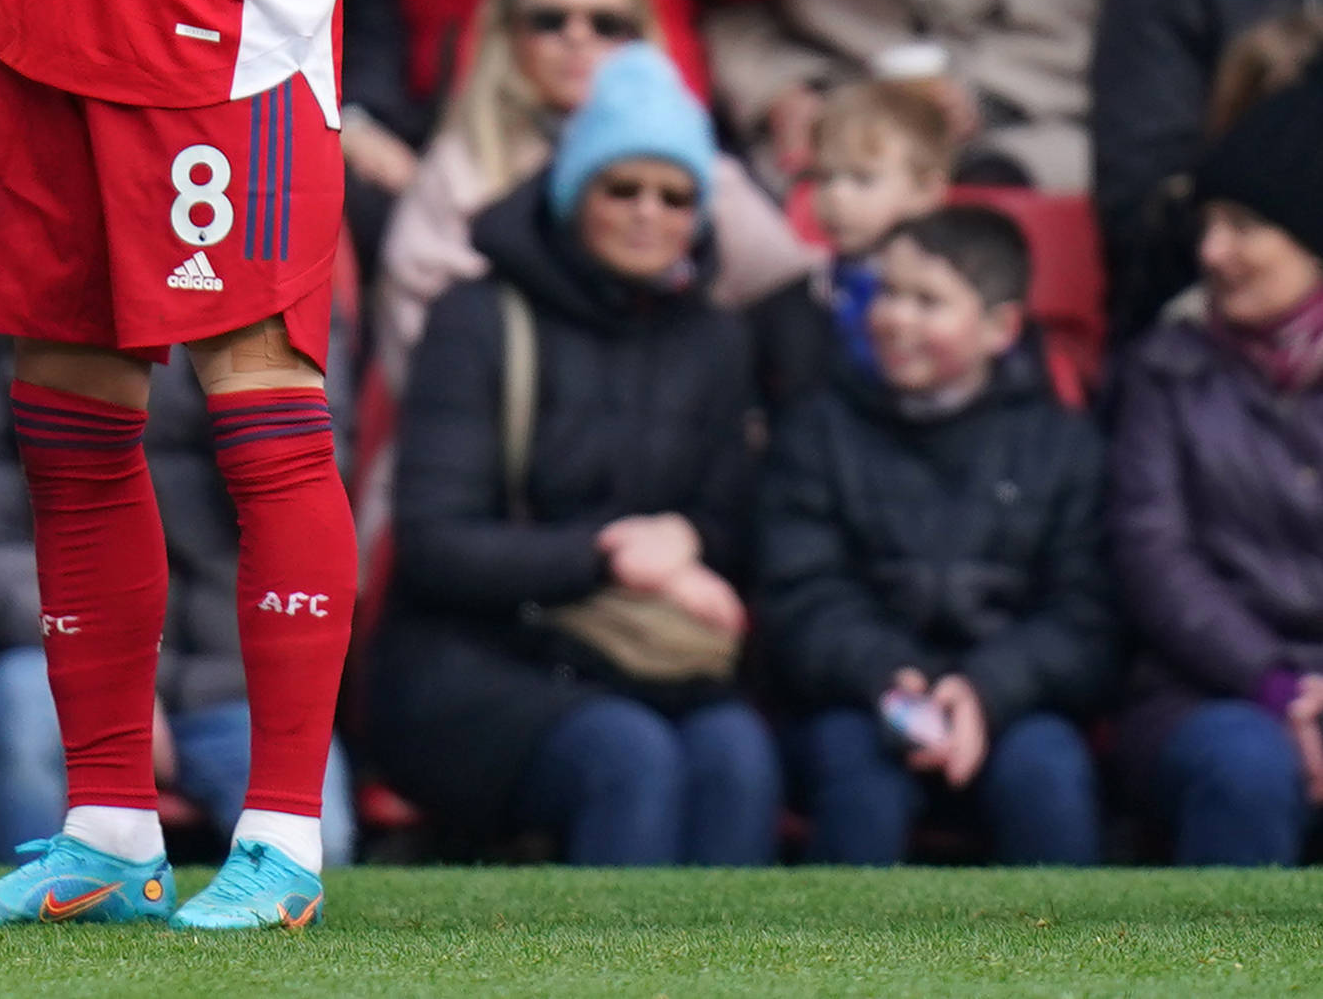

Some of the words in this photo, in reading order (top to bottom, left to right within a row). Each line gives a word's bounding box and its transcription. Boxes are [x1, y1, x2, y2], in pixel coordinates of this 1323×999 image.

[170, 144, 234, 246] 8
[167, 273, 224, 291] adidas
[258, 590, 330, 618] AFC
[39, 614, 82, 637] FC
